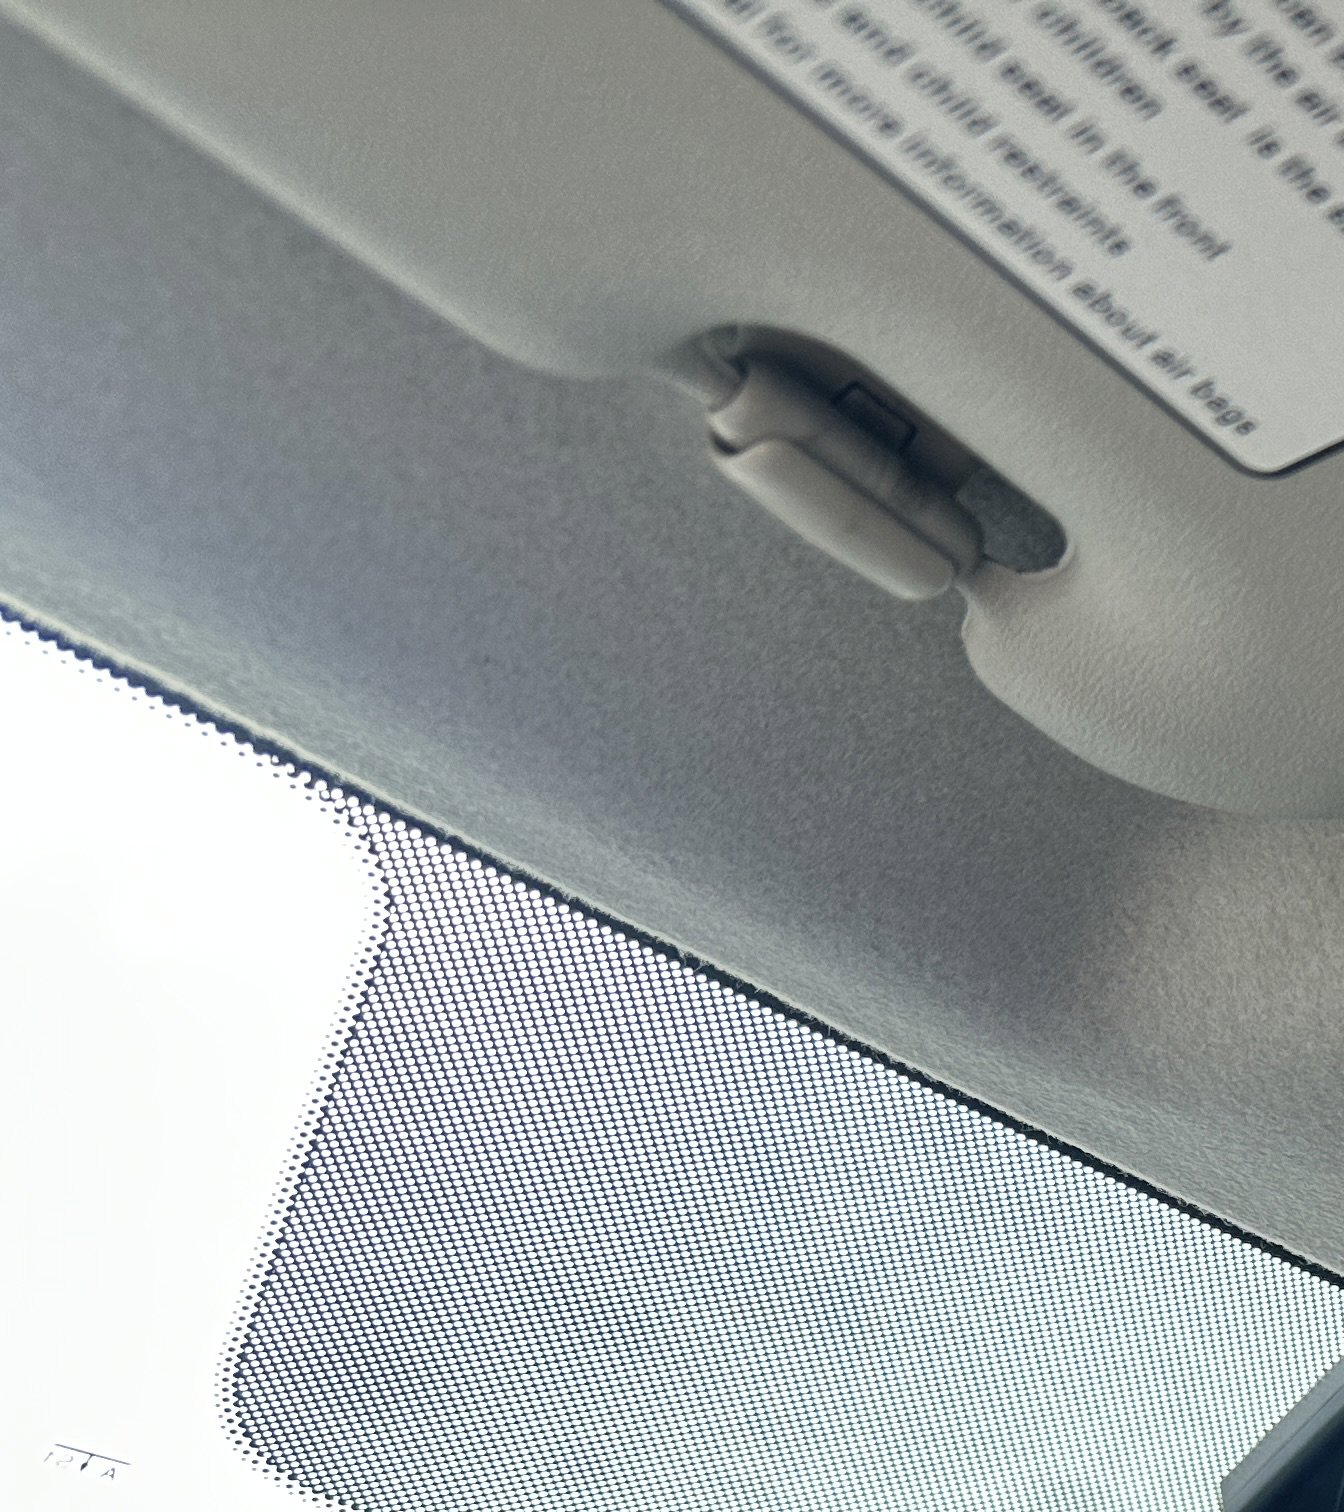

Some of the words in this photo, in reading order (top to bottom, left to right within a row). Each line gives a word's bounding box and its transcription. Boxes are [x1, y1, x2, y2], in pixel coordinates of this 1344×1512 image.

[1175, 61, 1249, 123] seat
[1277, 155, 1332, 205] the
[1244, 35, 1300, 88] the
[1294, 89, 1341, 125] air
[1068, 120, 1106, 154] in
[1102, 149, 1158, 199] the
[1152, 193, 1232, 261] front
[900, 132, 1074, 281] information
[1070, 281, 1160, 350] about
[1149, 349, 1195, 380] air
[1188, 378, 1259, 436] bags
